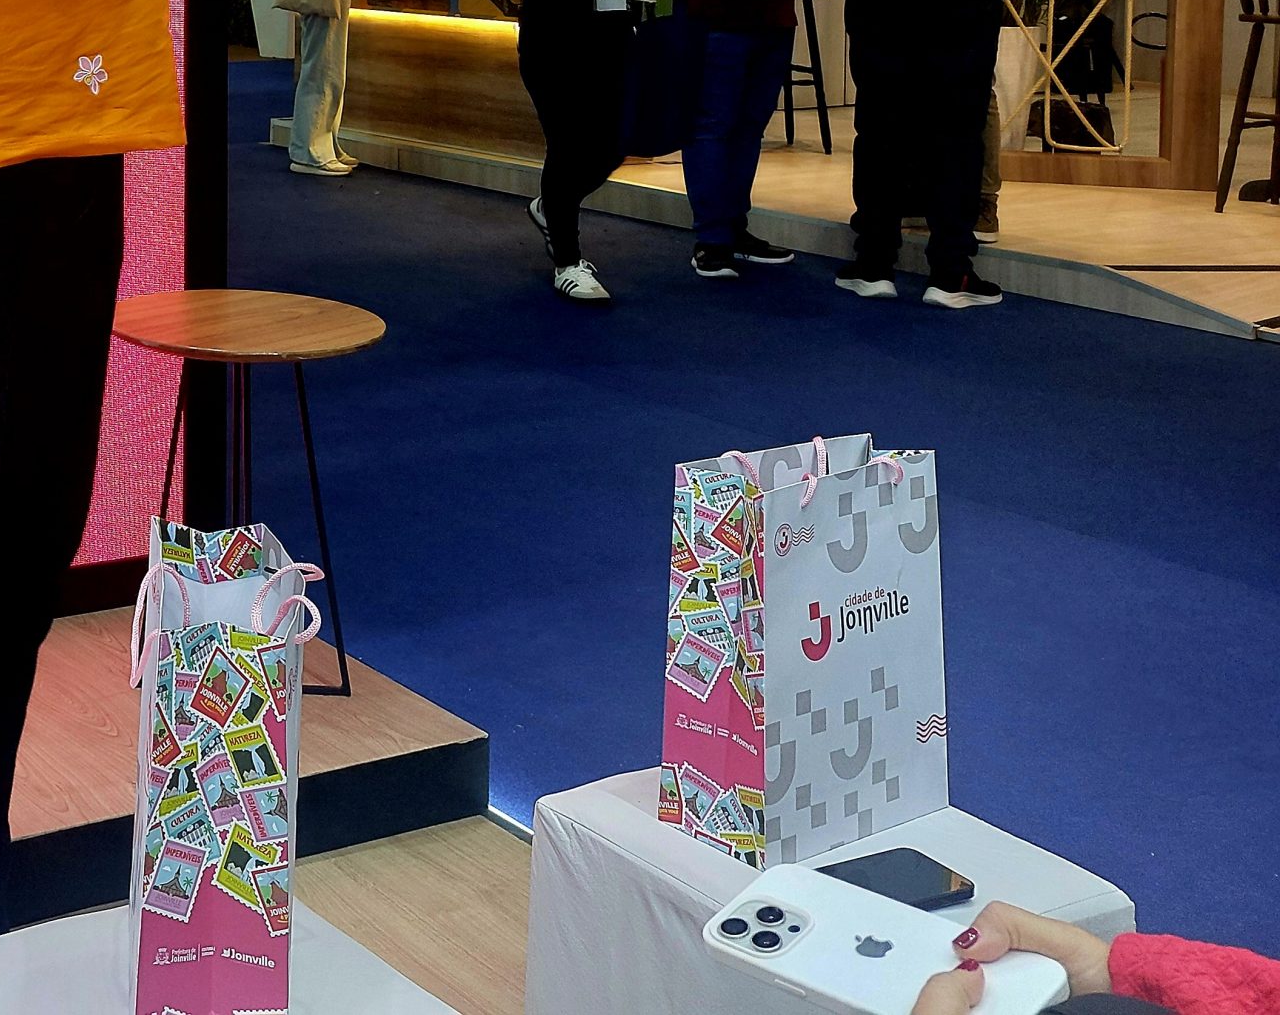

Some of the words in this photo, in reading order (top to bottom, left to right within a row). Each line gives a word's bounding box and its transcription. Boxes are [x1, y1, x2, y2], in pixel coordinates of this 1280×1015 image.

[163, 547, 190, 559] NATUREZA
[230, 540, 249, 573] JOINVILLE
[845, 590, 872, 607] cidade
[875, 586, 885, 599] de
[691, 614, 720, 626] CULTURA
[837, 590, 909, 643] Joinville
[686, 638, 720, 662] IMPERDÍVEIS
[200, 687, 229, 713] JOINVILLE
[229, 730, 262, 746] NATUREZA
[171, 804, 201, 828] CULTURA
[165, 846, 202, 865] IMPERDÍVEIS
[171, 952, 196, 963] Joinville
